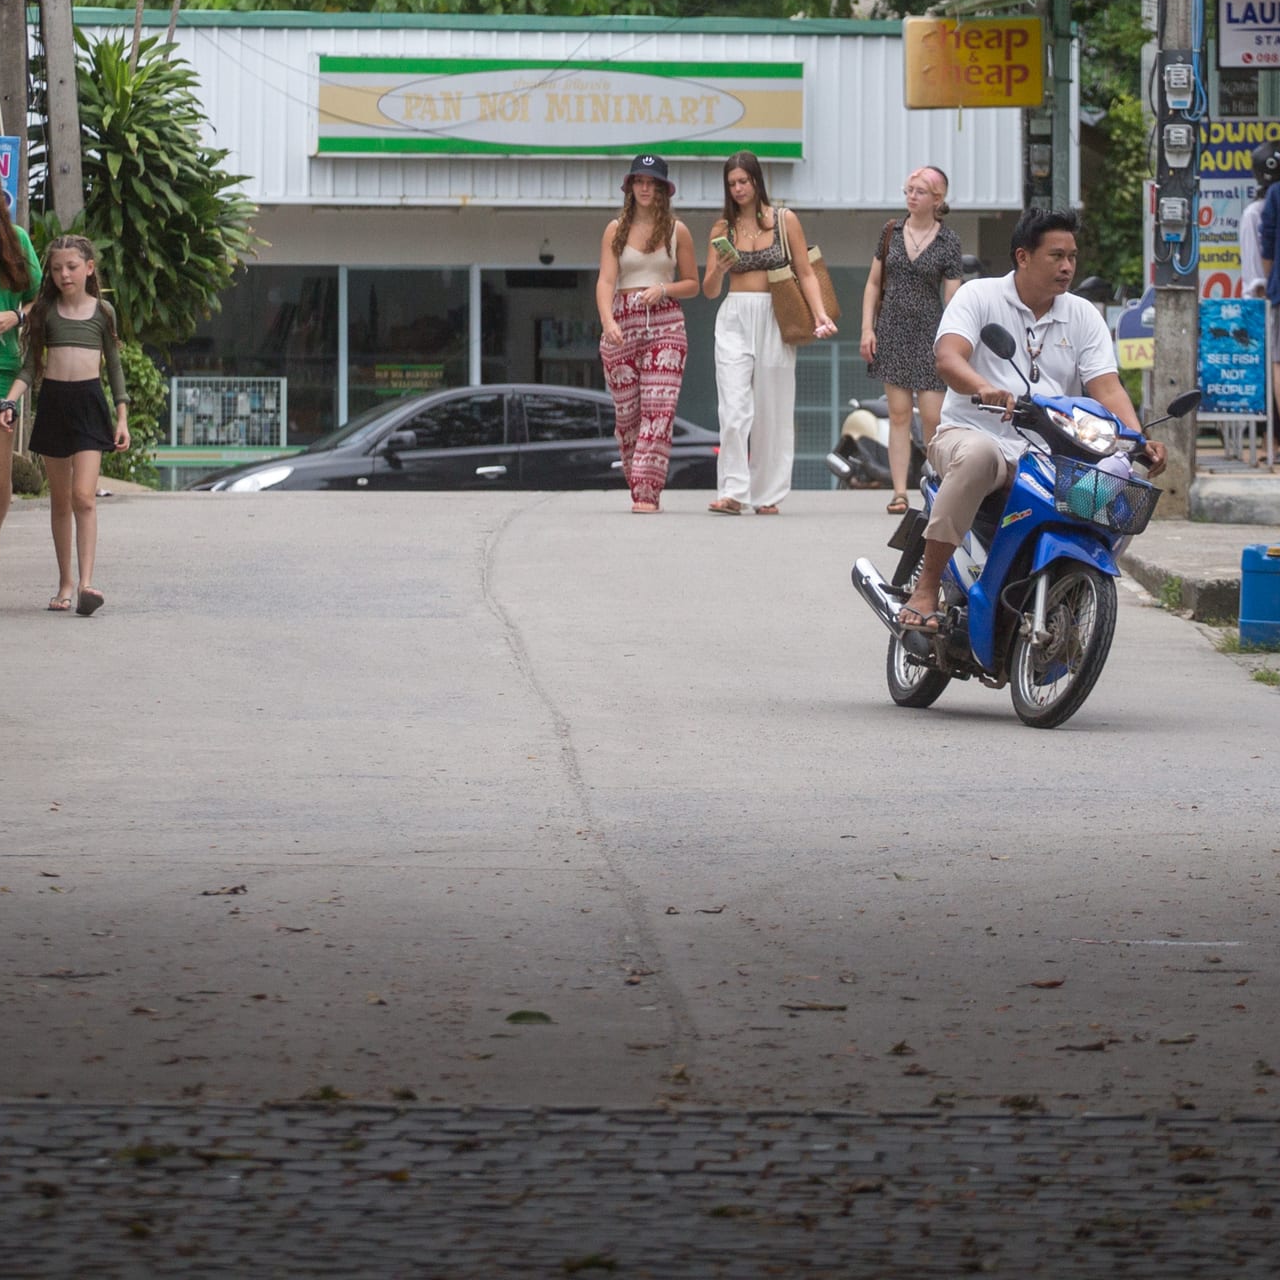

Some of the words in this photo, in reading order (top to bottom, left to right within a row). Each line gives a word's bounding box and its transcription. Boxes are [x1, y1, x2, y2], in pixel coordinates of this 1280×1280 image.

[402, 92, 463, 121] PAN
[478, 92, 530, 122] NOI
[546, 93, 720, 125] MINIMART
[1199, 186, 1240, 199] rmal
[1199, 249, 1241, 266] undry
[1207, 353, 1230, 365] SEE
[1232, 353, 1260, 365] FISH
[1221, 368, 1247, 380] NOT
